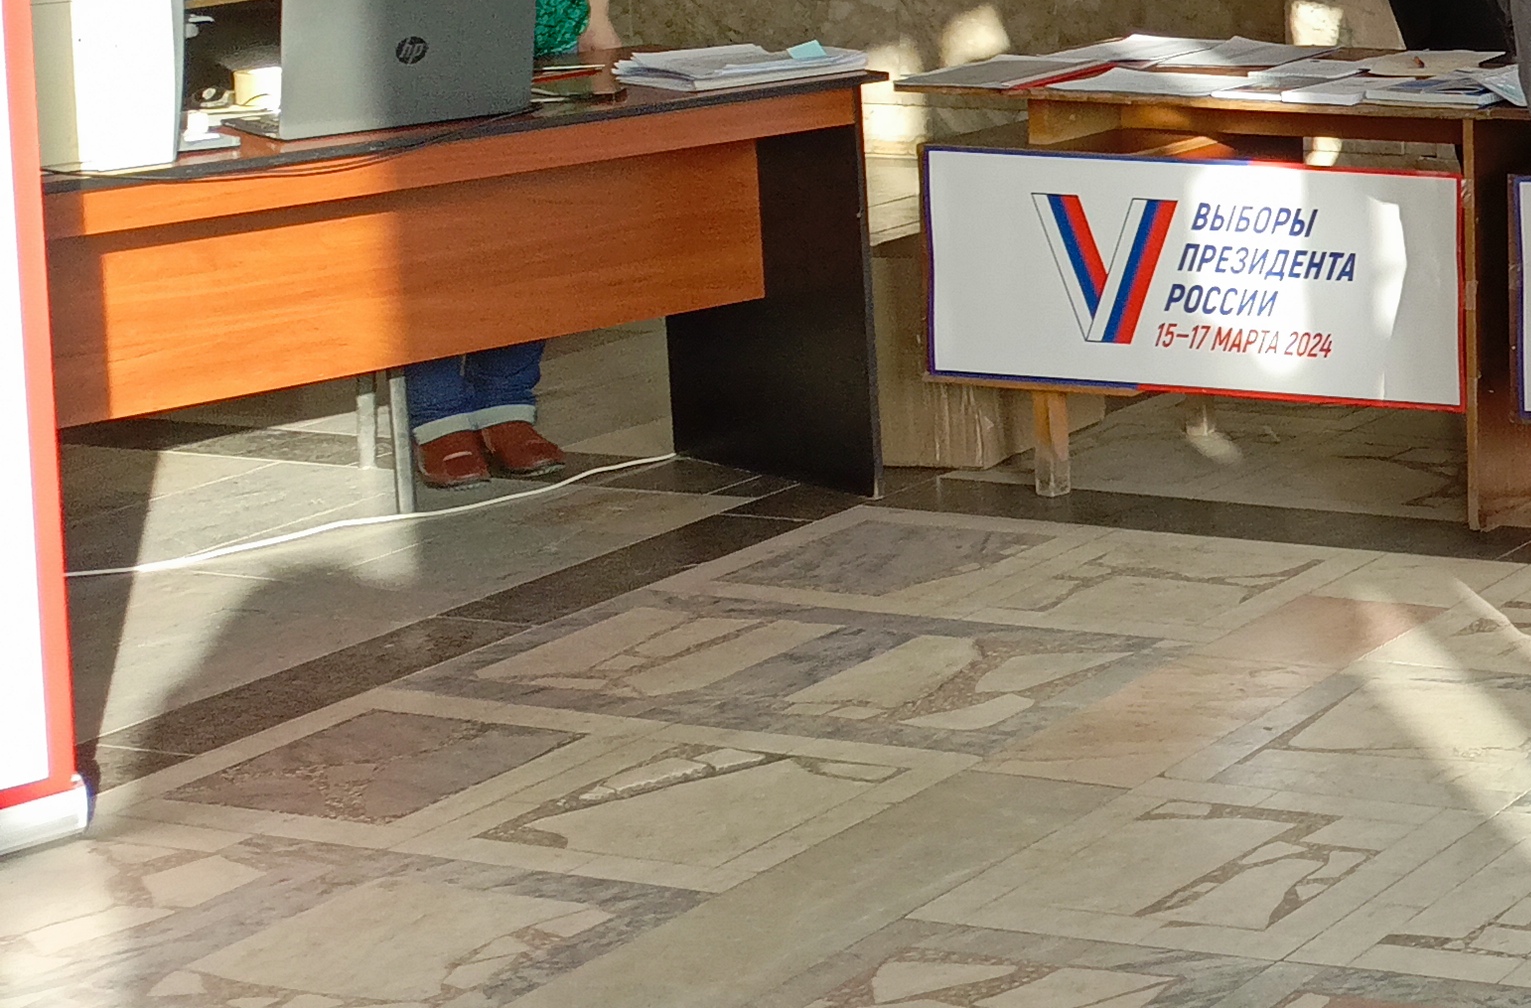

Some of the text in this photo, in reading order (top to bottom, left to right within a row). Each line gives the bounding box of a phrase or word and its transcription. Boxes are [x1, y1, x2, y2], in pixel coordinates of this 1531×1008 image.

[399, 36, 424, 65] hp
[1191, 202, 1318, 238] ВЫБОРЫ
[1177, 243, 1356, 281] ПРЕЗИДЕНТА
[1164, 283, 1278, 317] РОССИИ
[1210, 326, 1280, 354] МАРТА
[1284, 331, 1333, 358] 2024
